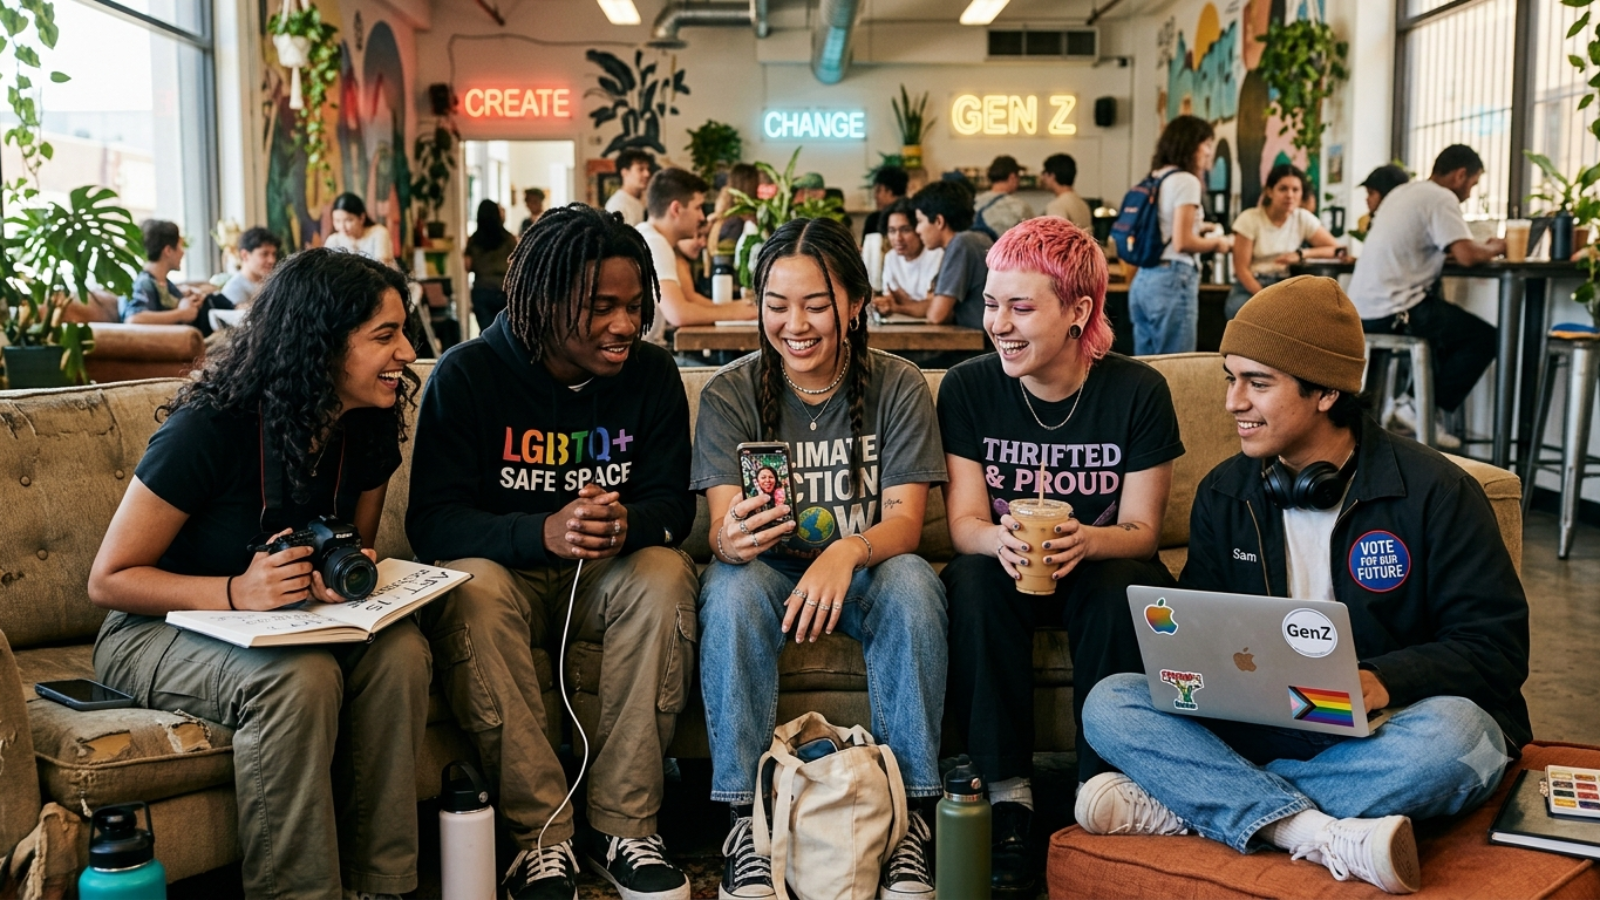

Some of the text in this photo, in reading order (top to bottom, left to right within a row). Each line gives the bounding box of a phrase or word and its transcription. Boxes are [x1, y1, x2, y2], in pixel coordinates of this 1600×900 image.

[464, 88, 570, 117] CREATE
[951, 94, 1077, 135] GEN Z
[764, 111, 865, 138] CHANGE
[502, 426, 634, 466] LGBTQ+
[983, 437, 1122, 468] THRIFTED
[499, 461, 632, 492] SAFE SPACE
[985, 465, 1120, 496] & PROUD
[1232, 548, 1257, 563] Sam
[1360, 539, 1395, 555] VOTE
[1357, 564, 1405, 581] FUTURE
[1286, 623, 1332, 641] GenZ
